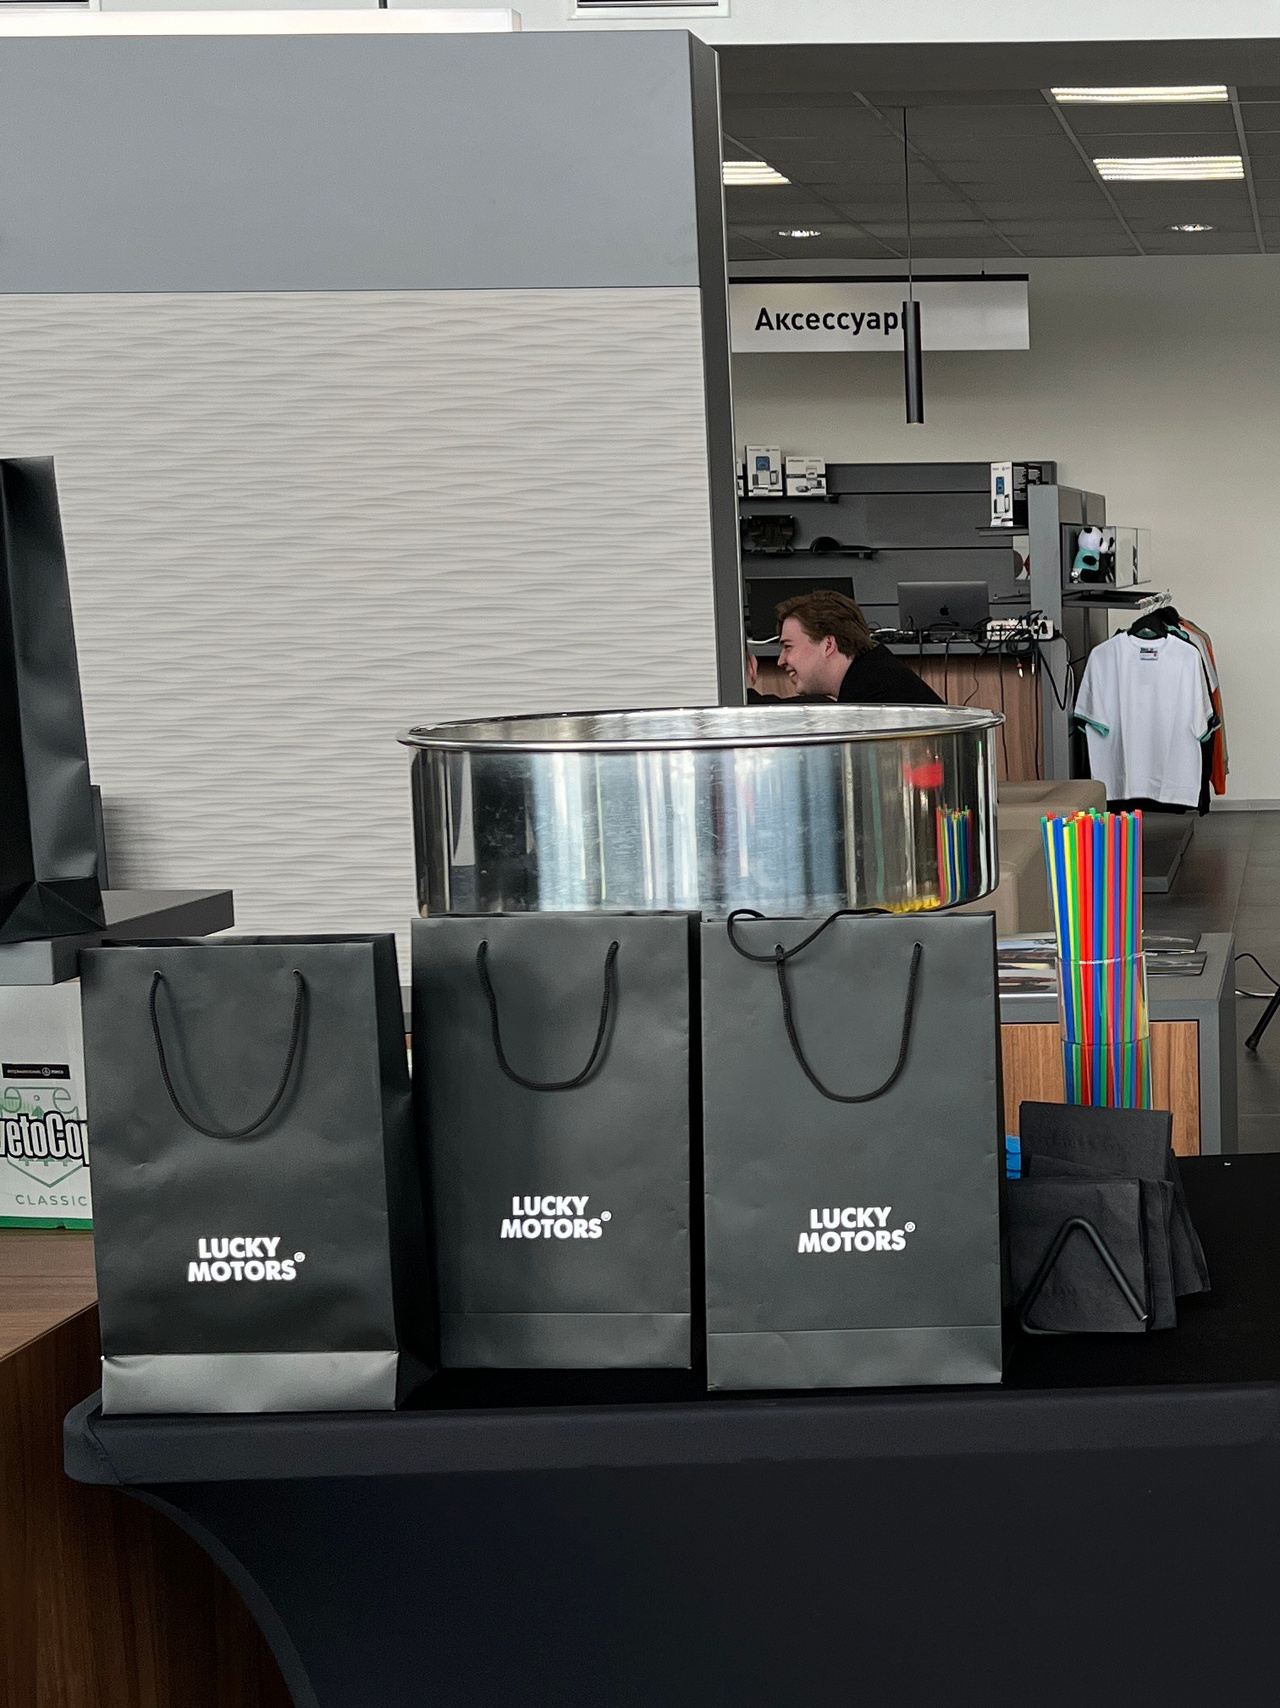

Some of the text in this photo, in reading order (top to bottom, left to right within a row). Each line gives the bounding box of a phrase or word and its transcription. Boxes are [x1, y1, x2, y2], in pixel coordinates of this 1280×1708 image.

[754, 306, 905, 336] Аксессуар
[15, 1194, 88, 1207] CLASSIC
[511, 1195, 590, 1217] LUCKY
[809, 1206, 892, 1229] LUCKY
[198, 1236, 281, 1259] LUCKY
